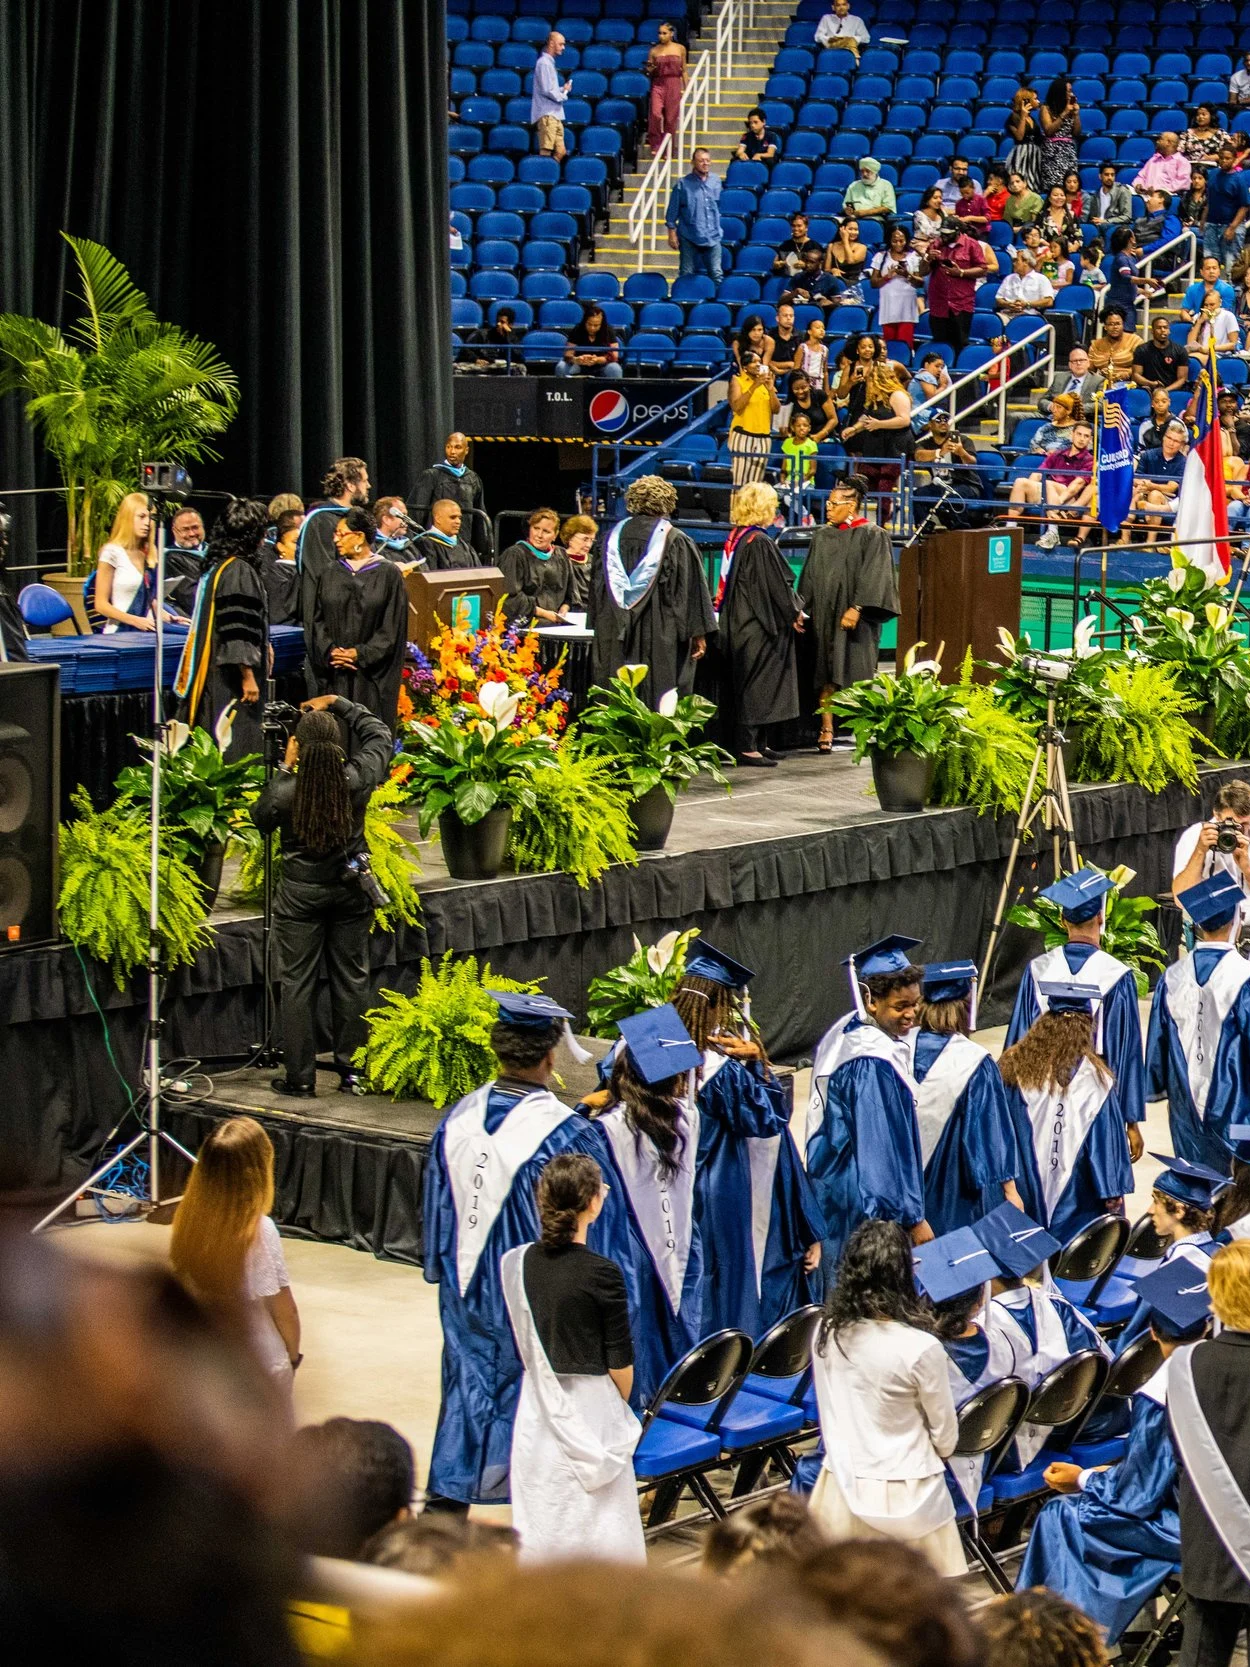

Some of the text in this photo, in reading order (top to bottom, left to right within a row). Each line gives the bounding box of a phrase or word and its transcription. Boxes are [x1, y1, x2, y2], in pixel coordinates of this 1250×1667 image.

[546, 391, 573, 402] T.O.L.
[633, 404, 690, 423] peps
[1196, 1001, 1204, 1065] 2019
[1050, 1102, 1065, 1172] 2019
[467, 1151, 489, 1230] 2019
[659, 1177, 676, 1256] 2019
